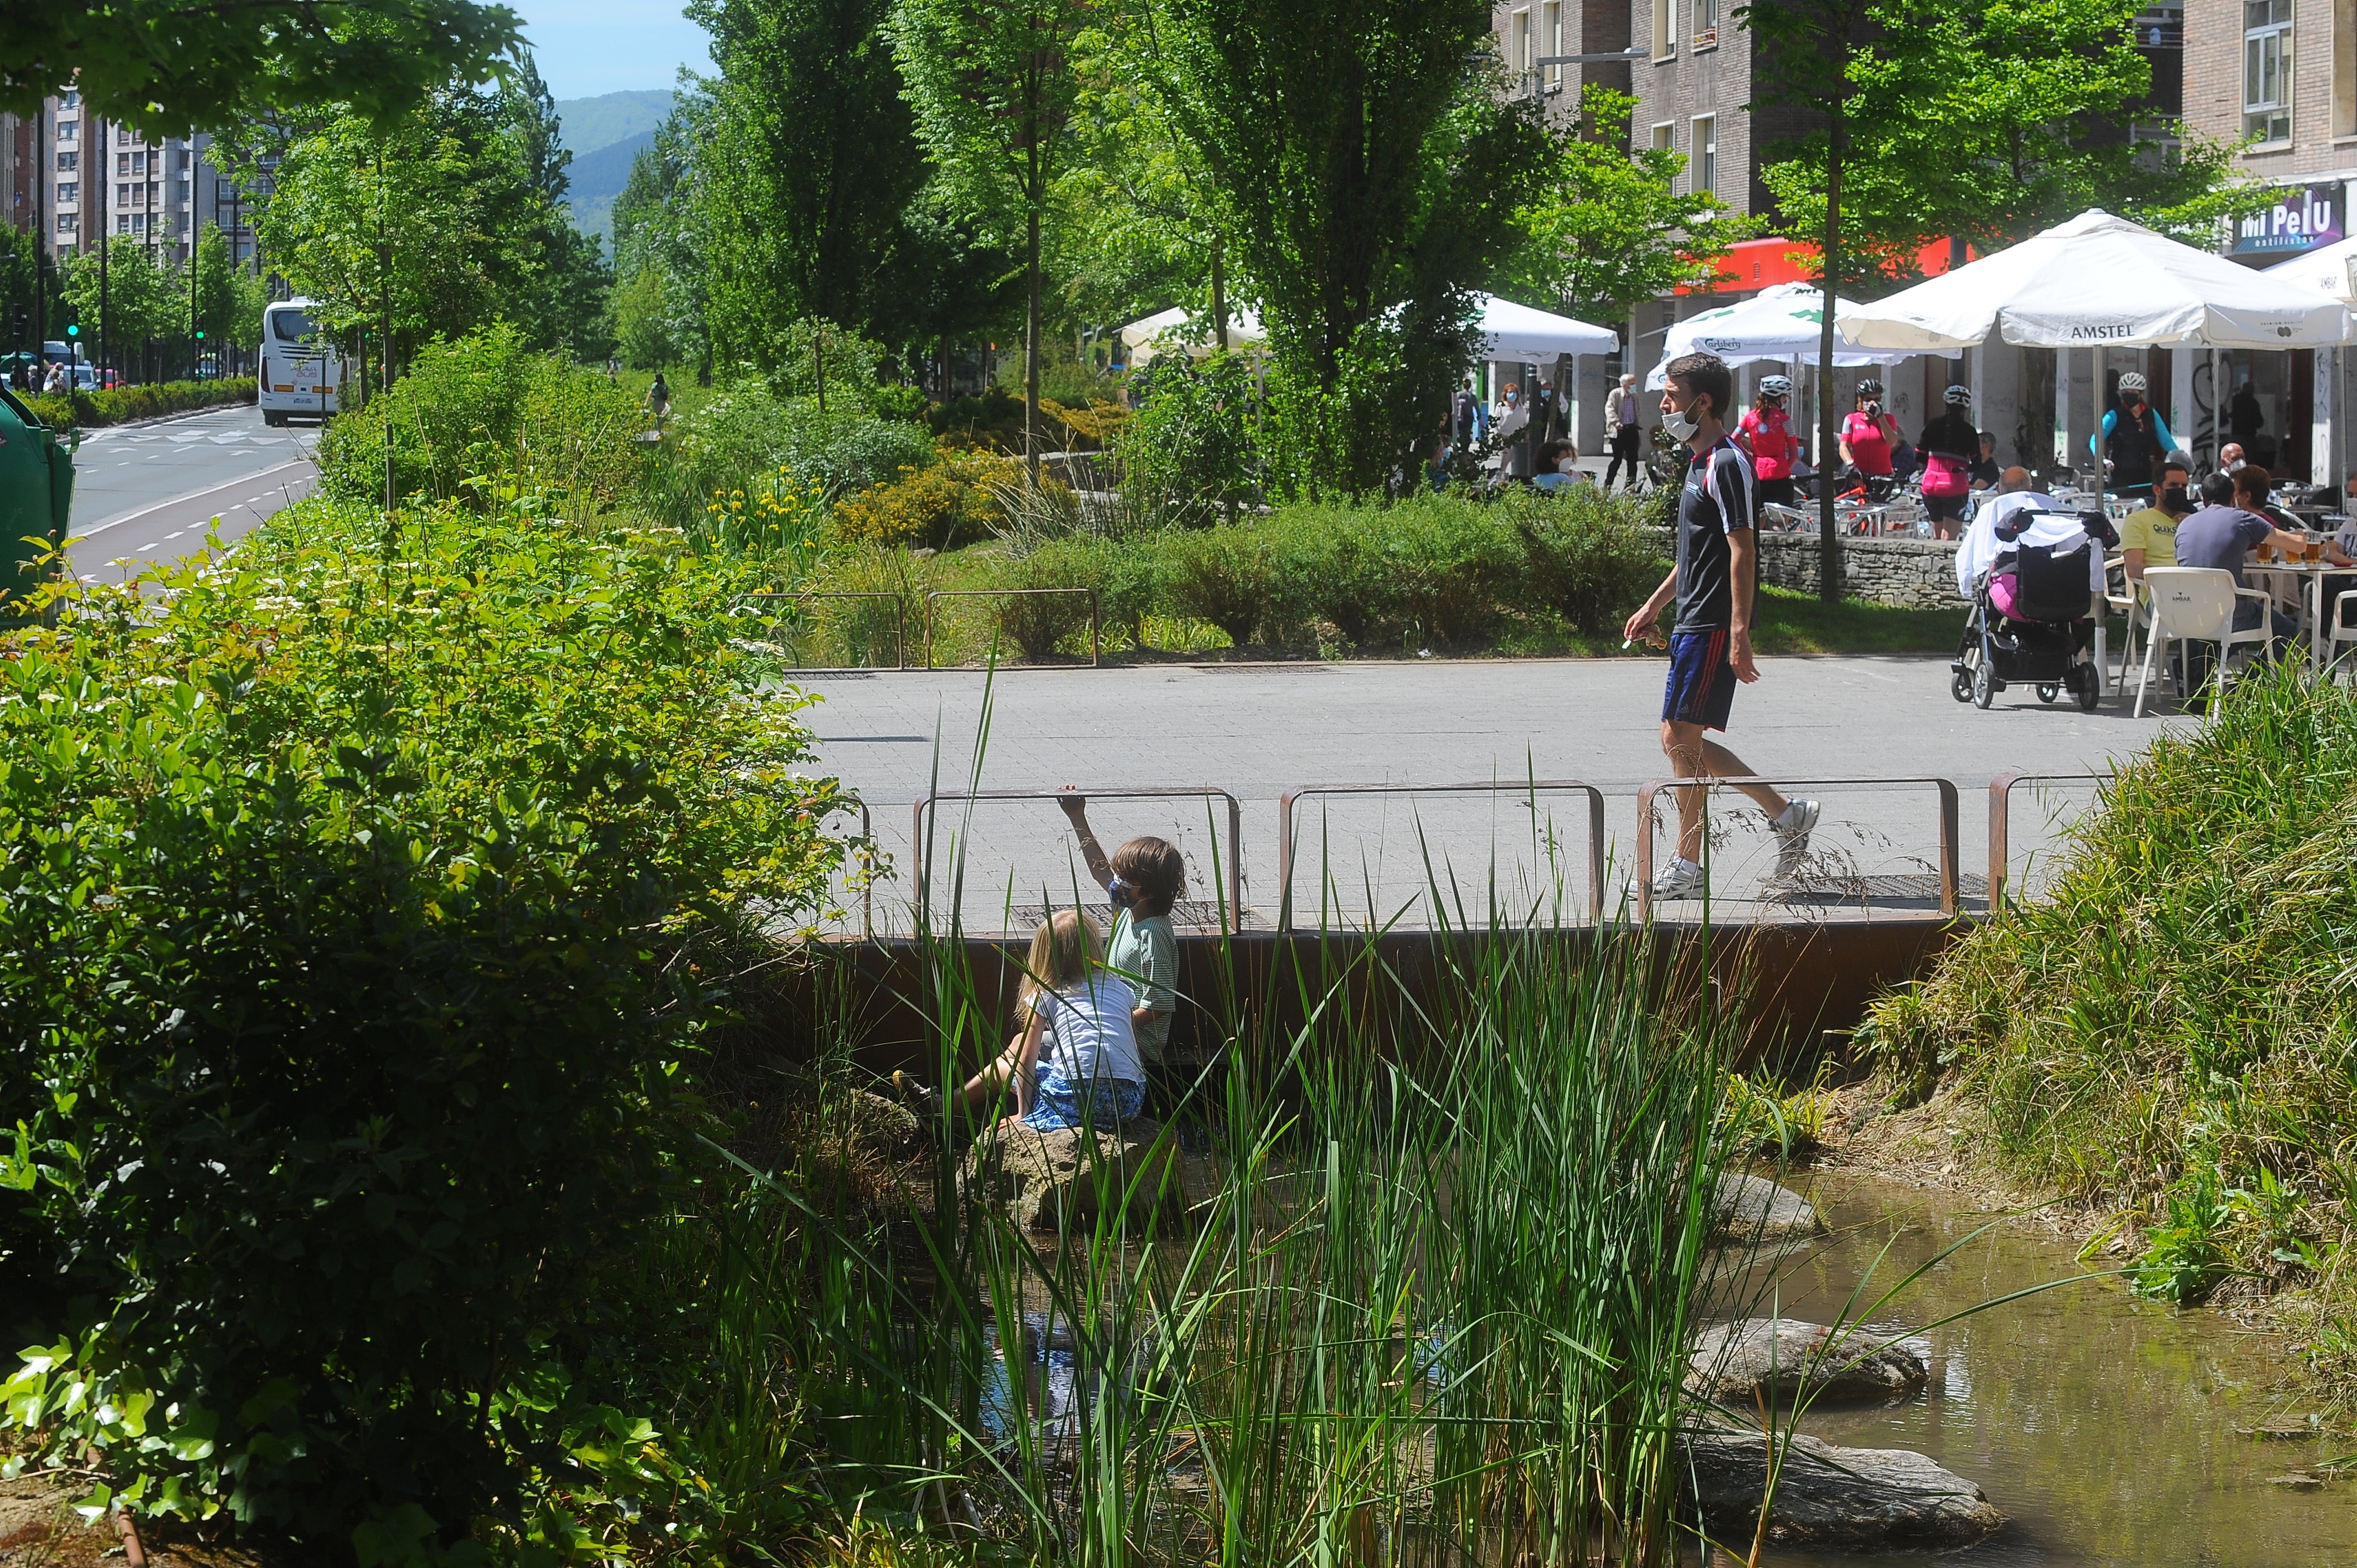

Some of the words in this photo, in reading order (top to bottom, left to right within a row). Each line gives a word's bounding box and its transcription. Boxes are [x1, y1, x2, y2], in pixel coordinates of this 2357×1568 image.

[2241, 210, 2266, 238] Mi
[2255, 236, 2314, 247] estilistas
[2071, 324, 2135, 339] AMSTEL
[1705, 338, 1741, 350] Carlsberg
